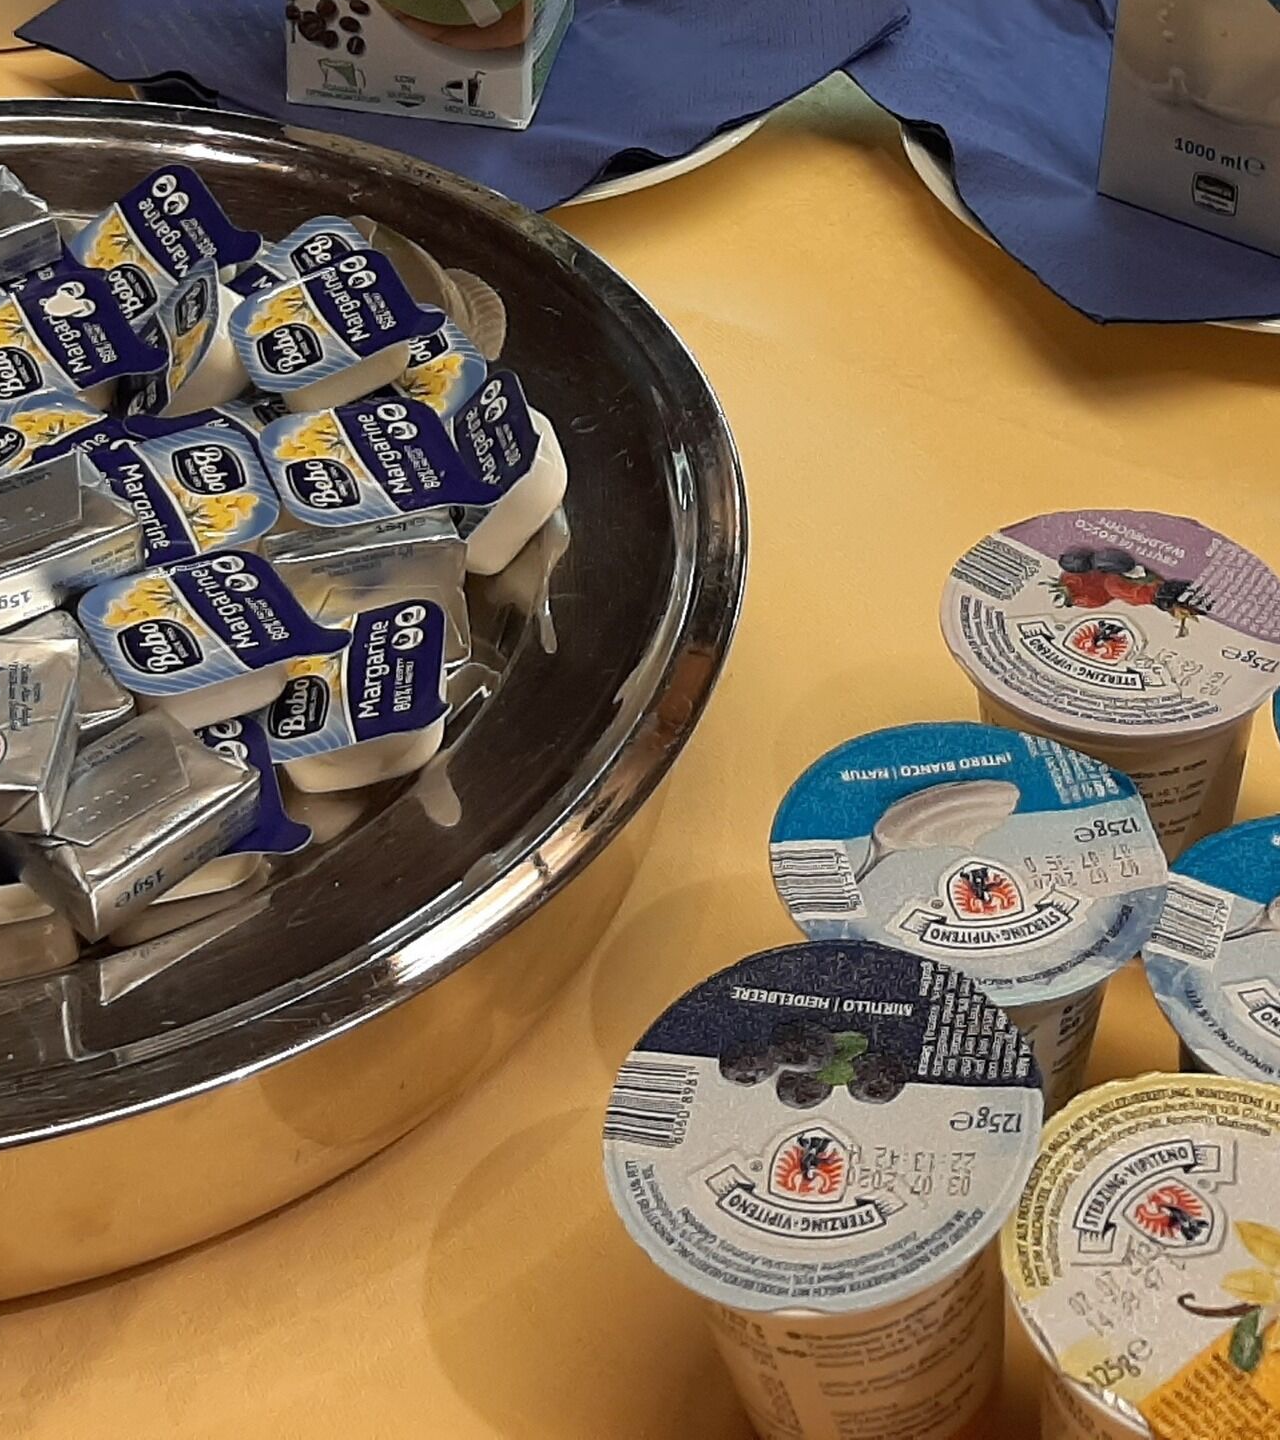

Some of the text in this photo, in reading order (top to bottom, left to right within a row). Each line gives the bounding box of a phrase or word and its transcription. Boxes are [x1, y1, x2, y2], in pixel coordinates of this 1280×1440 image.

[1173, 136, 1216, 162] 1000
[138, 198, 191, 279] Margarine
[321, 269, 371, 343] Margarine
[271, 327, 307, 373] Bebo
[190, 445, 228, 494] Bebo
[356, 413, 415, 496] Margarine
[118, 462, 173, 551] Margarine
[303, 459, 341, 509] Bebo
[190, 565, 260, 650] Margarine
[138, 621, 181, 673] Bebo
[357, 618, 390, 720] Margarine
[276, 678, 311, 738] Bebo
[900, 759, 957, 779] BIANCO
[958, 751, 1014, 770] INTERO
